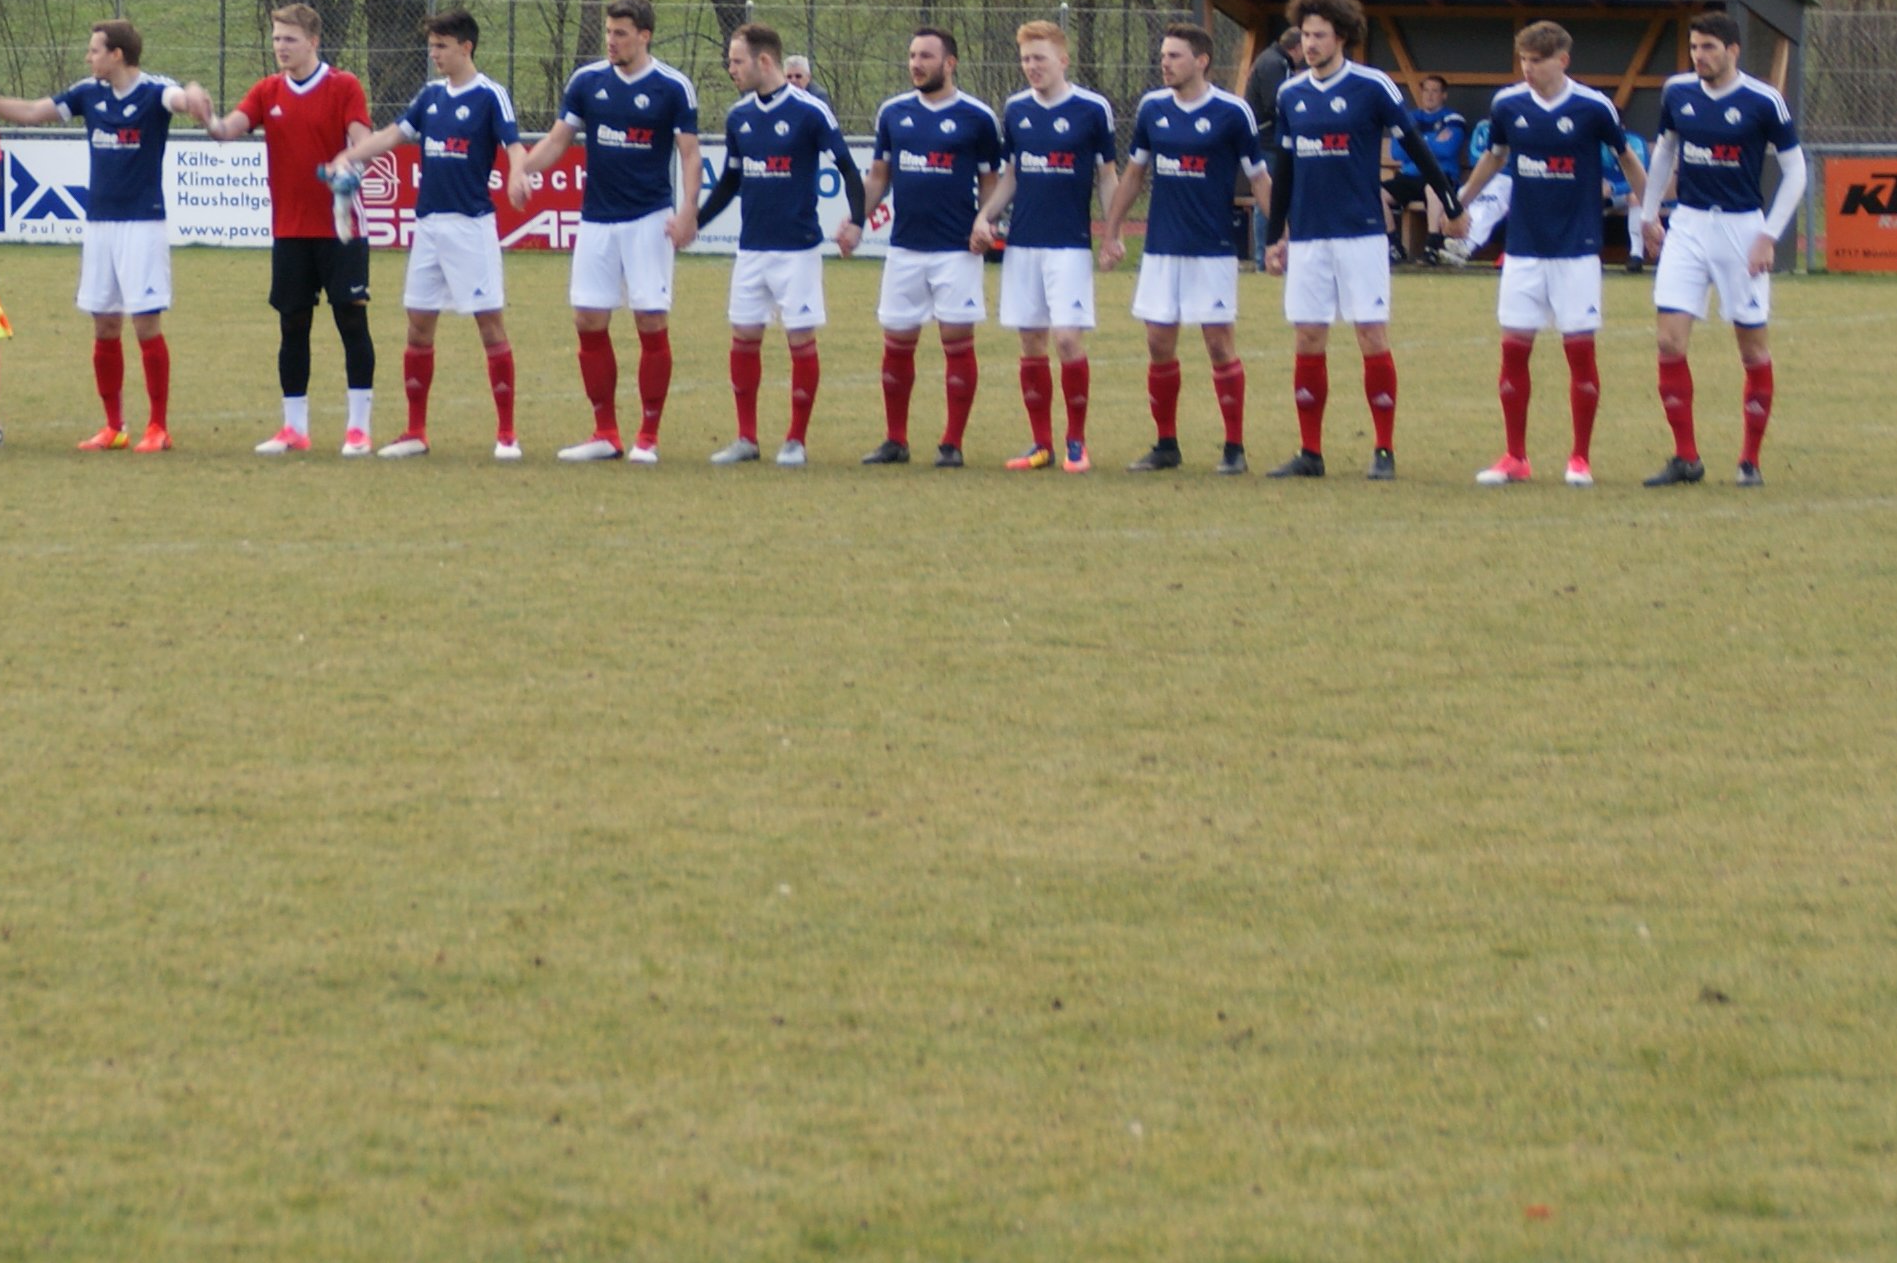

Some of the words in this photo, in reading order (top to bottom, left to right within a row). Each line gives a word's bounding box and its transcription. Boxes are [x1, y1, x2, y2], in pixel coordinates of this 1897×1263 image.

[177, 150, 225, 167] Kälte-
[231, 151, 262, 167] und
[177, 171, 270, 187] Klimatechn
[177, 191, 272, 210] Haushaltge
[19, 222, 54, 234] Paul
[178, 224, 270, 240] www.pava
